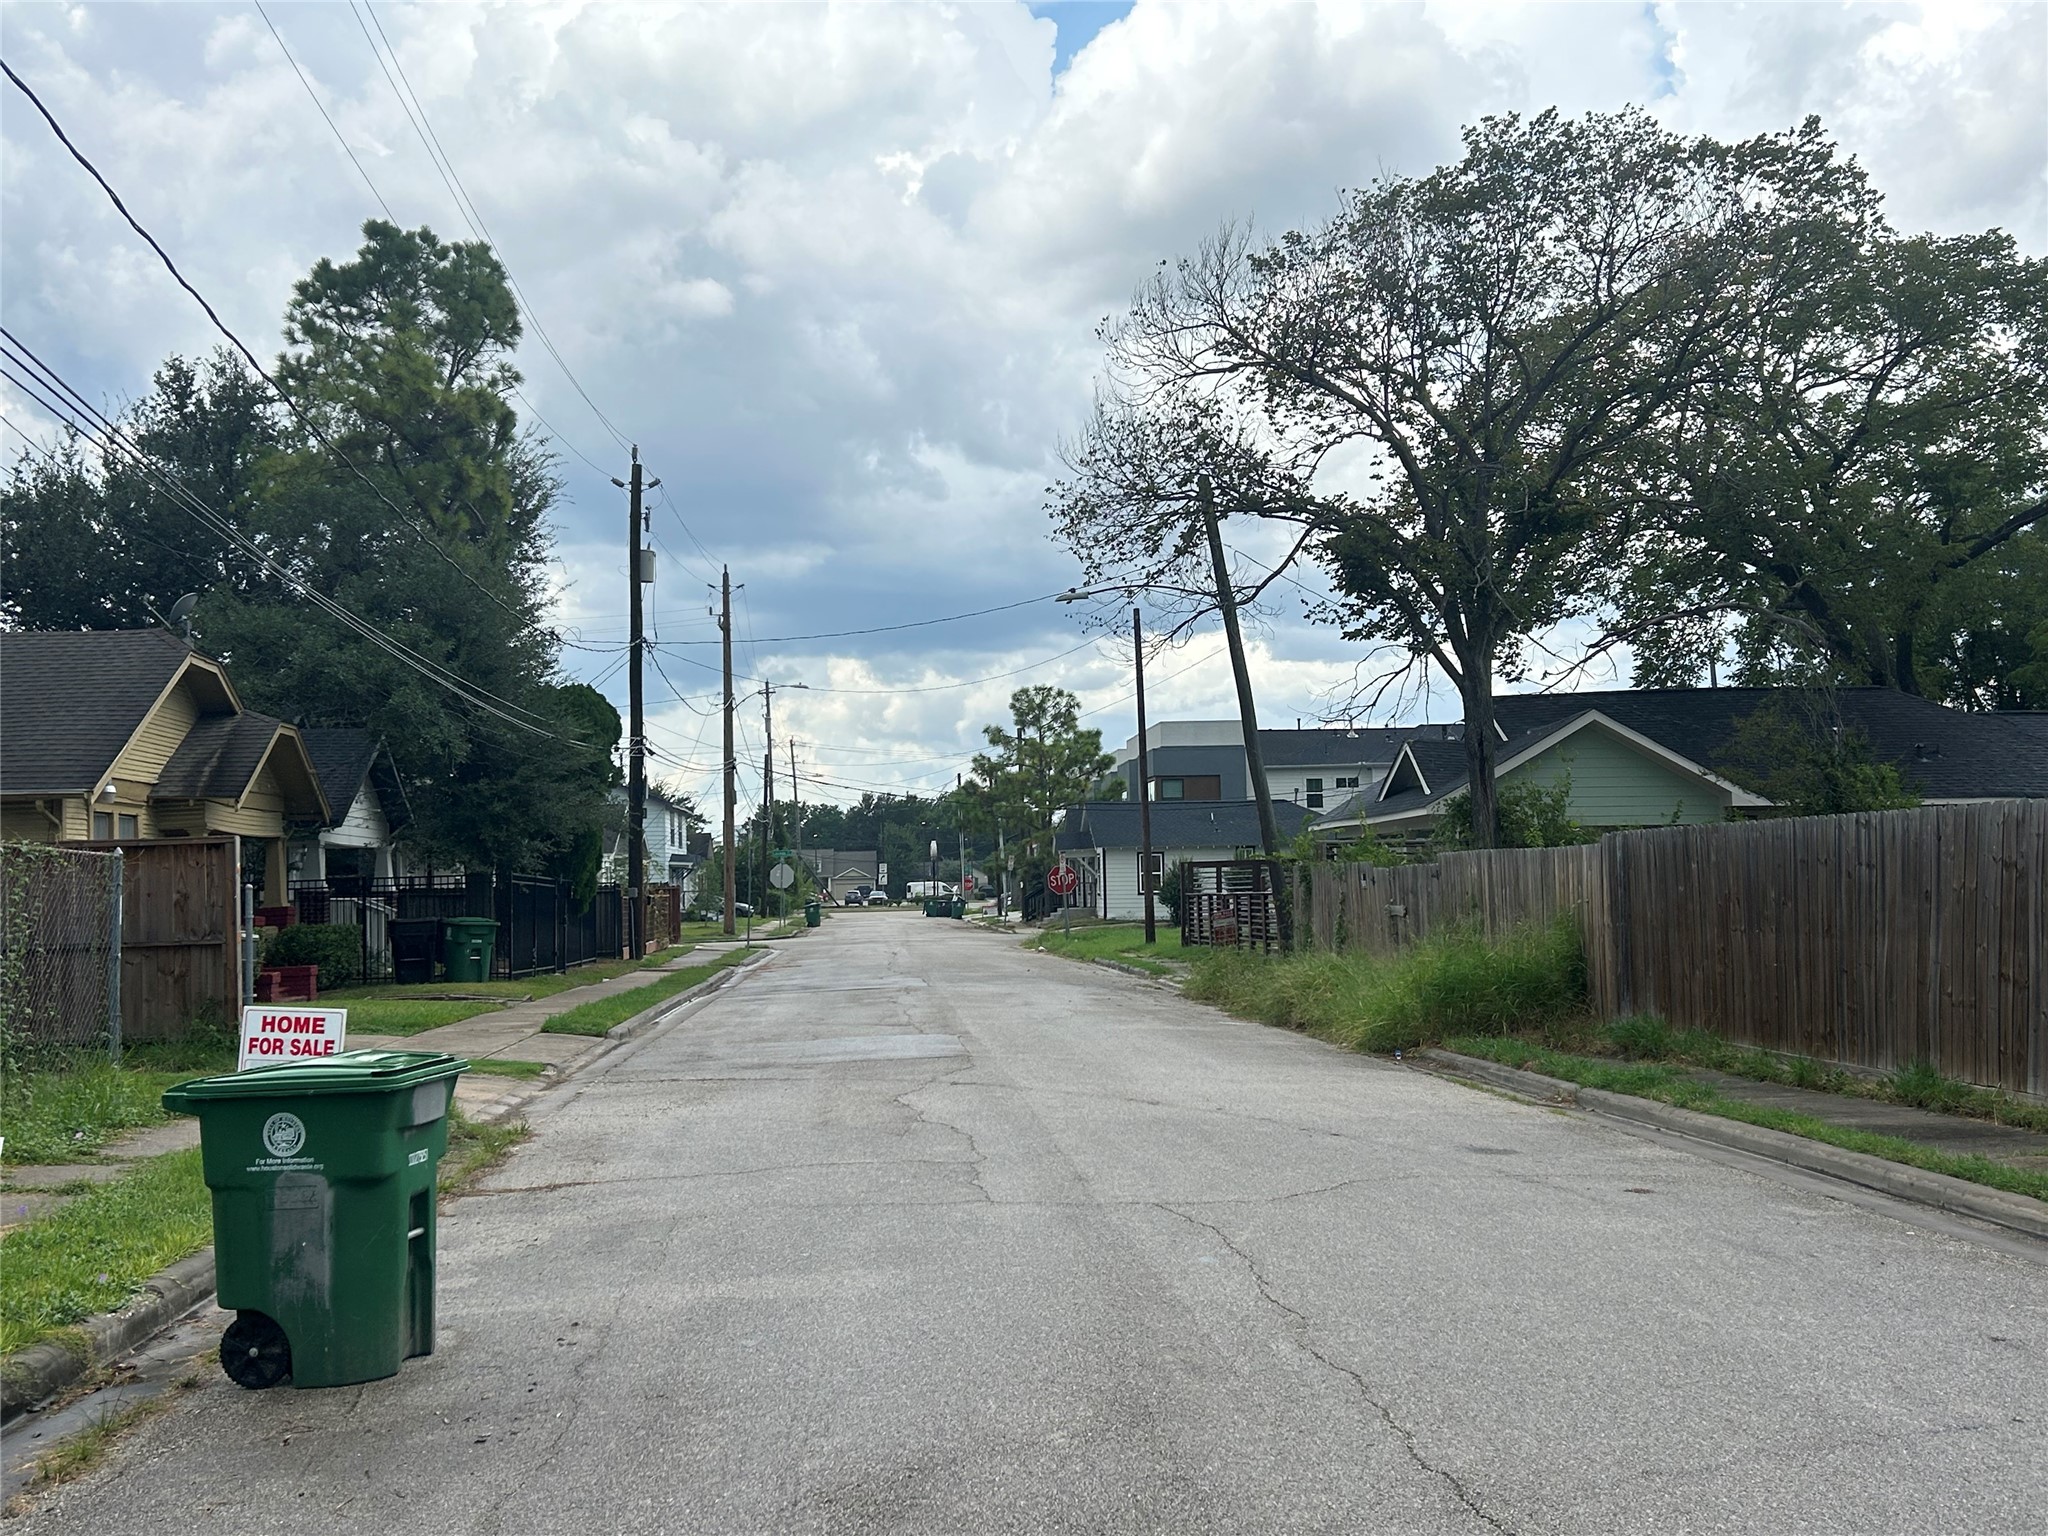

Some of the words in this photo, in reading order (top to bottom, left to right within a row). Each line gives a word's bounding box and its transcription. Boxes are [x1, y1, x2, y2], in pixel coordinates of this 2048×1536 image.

[1050, 873, 1074, 887] STOP
[261, 1015, 326, 1034] HOME
[248, 1037, 284, 1055] FOR
[290, 1038, 335, 1056] SALE
